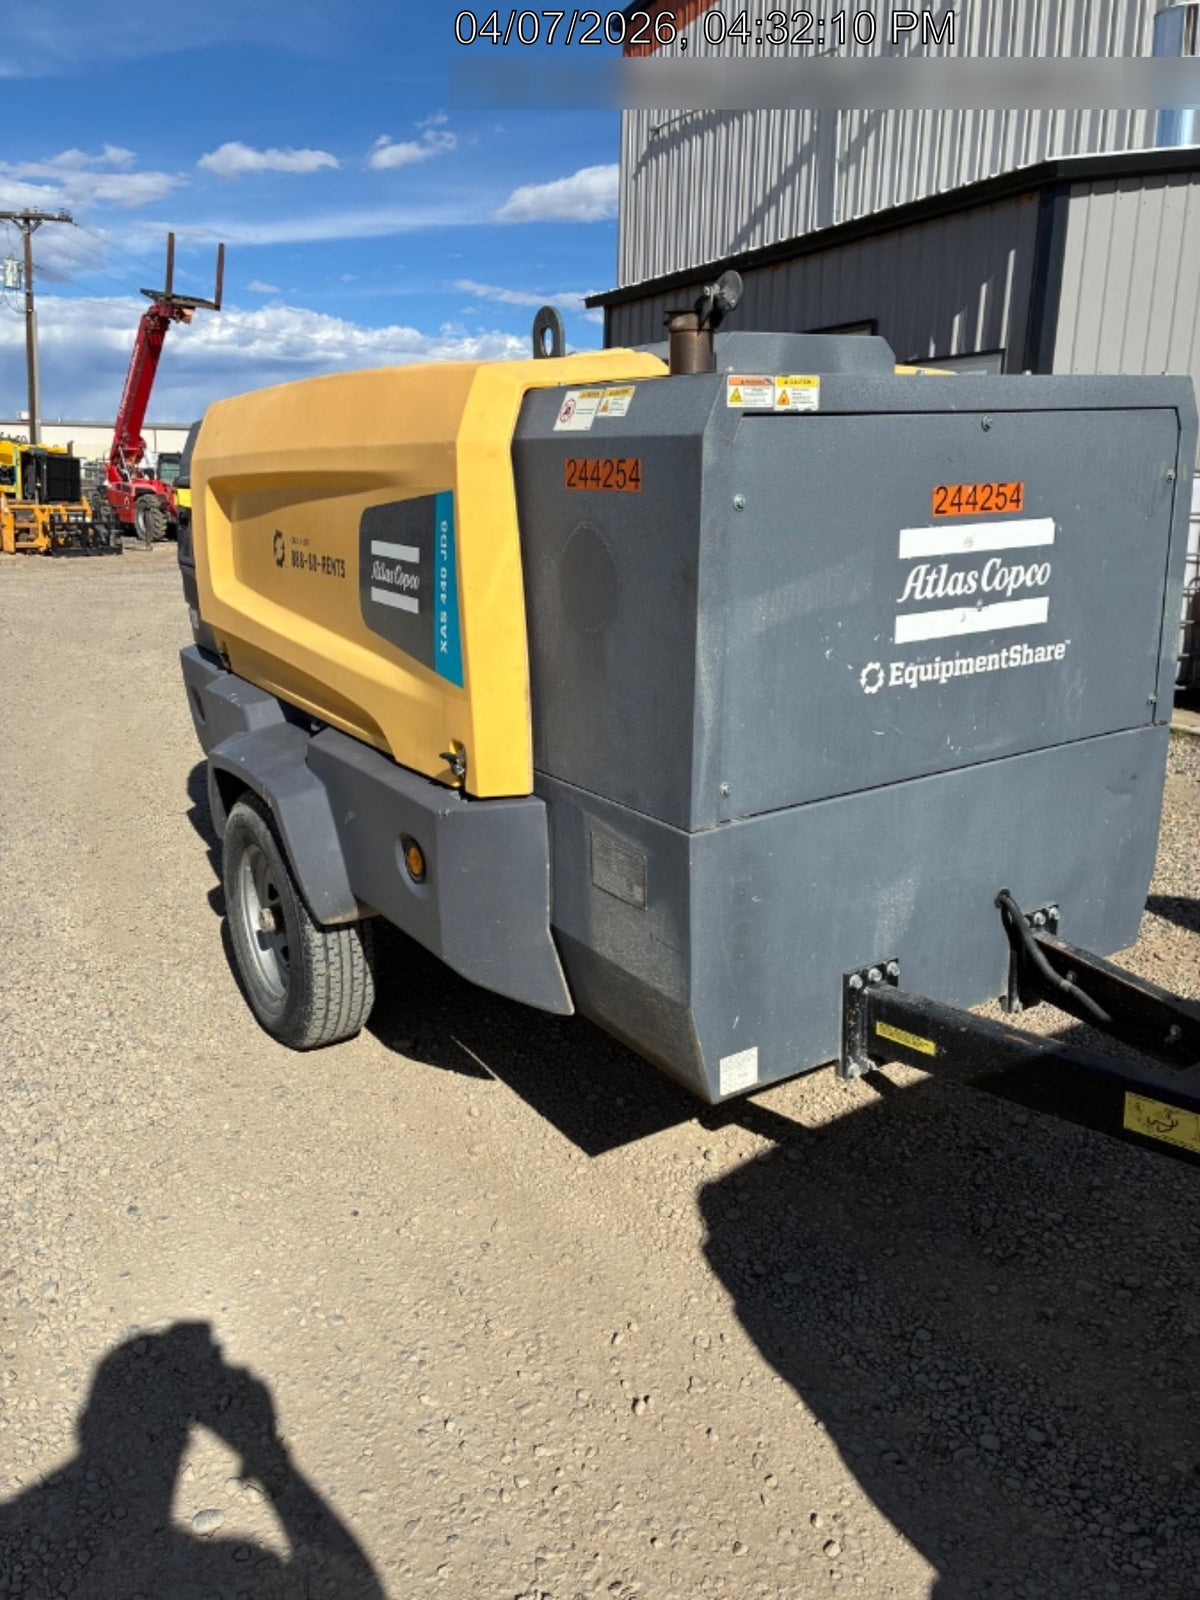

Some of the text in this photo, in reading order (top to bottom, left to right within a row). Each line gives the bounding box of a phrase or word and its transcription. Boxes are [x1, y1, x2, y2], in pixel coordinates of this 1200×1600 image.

[566, 458, 641, 489] 244254
[934, 482, 1022, 514] 244254
[896, 557, 1052, 603] Atlas Copco
